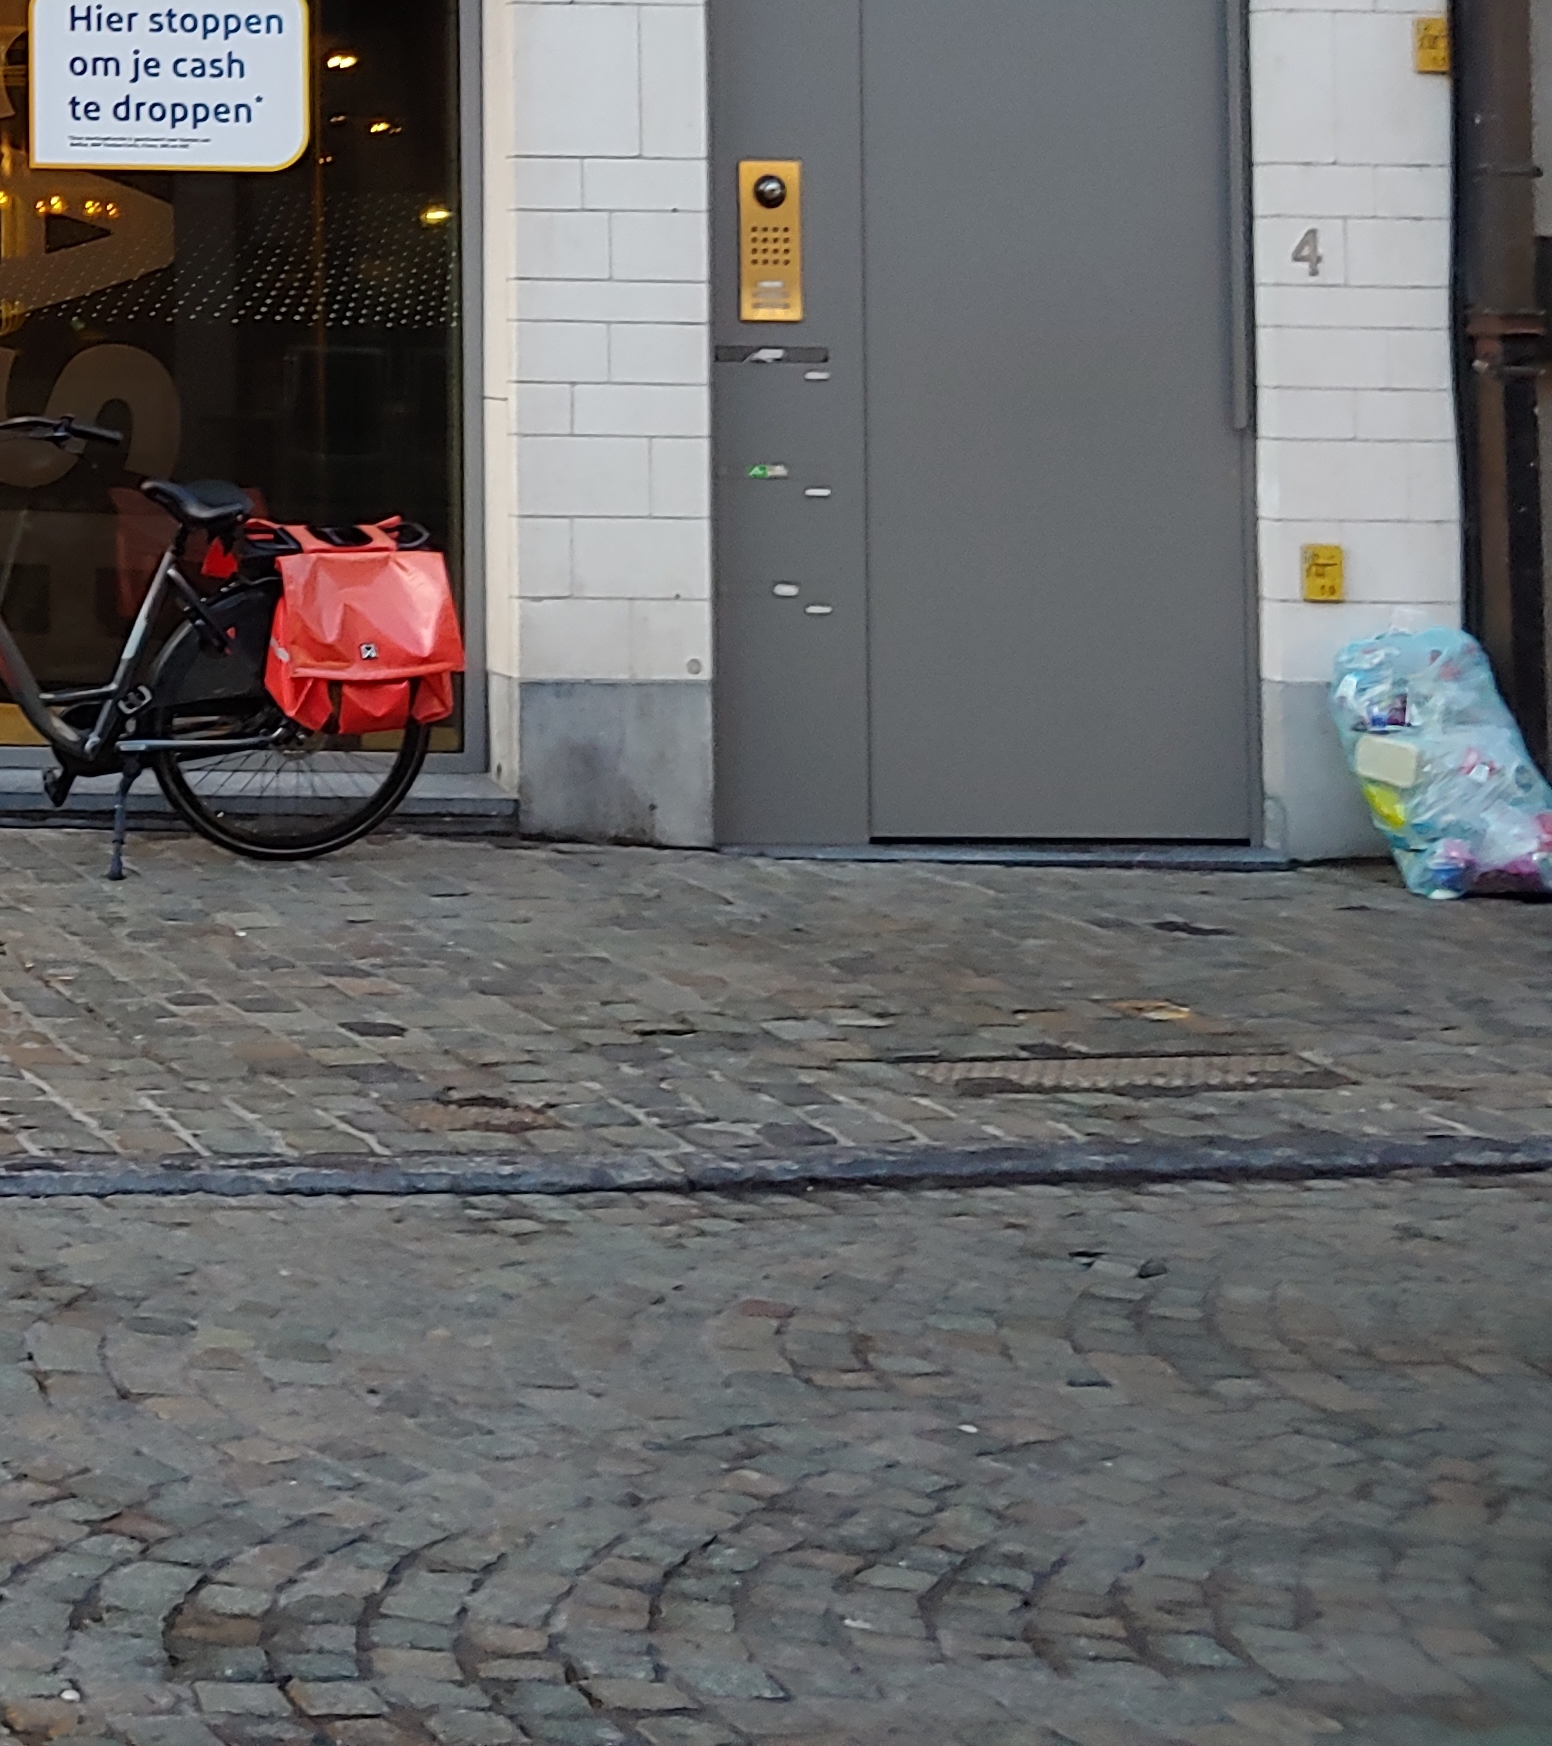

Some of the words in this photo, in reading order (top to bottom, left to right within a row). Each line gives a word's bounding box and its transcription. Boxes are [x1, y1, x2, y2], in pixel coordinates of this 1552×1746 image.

[69, 4, 139, 33] Hier
[148, 8, 284, 41] stoppen
[68, 55, 121, 77] om
[128, 49, 161, 84] je
[172, 50, 246, 79] cash
[68, 96, 101, 122] te
[1291, 228, 1323, 277] 4
